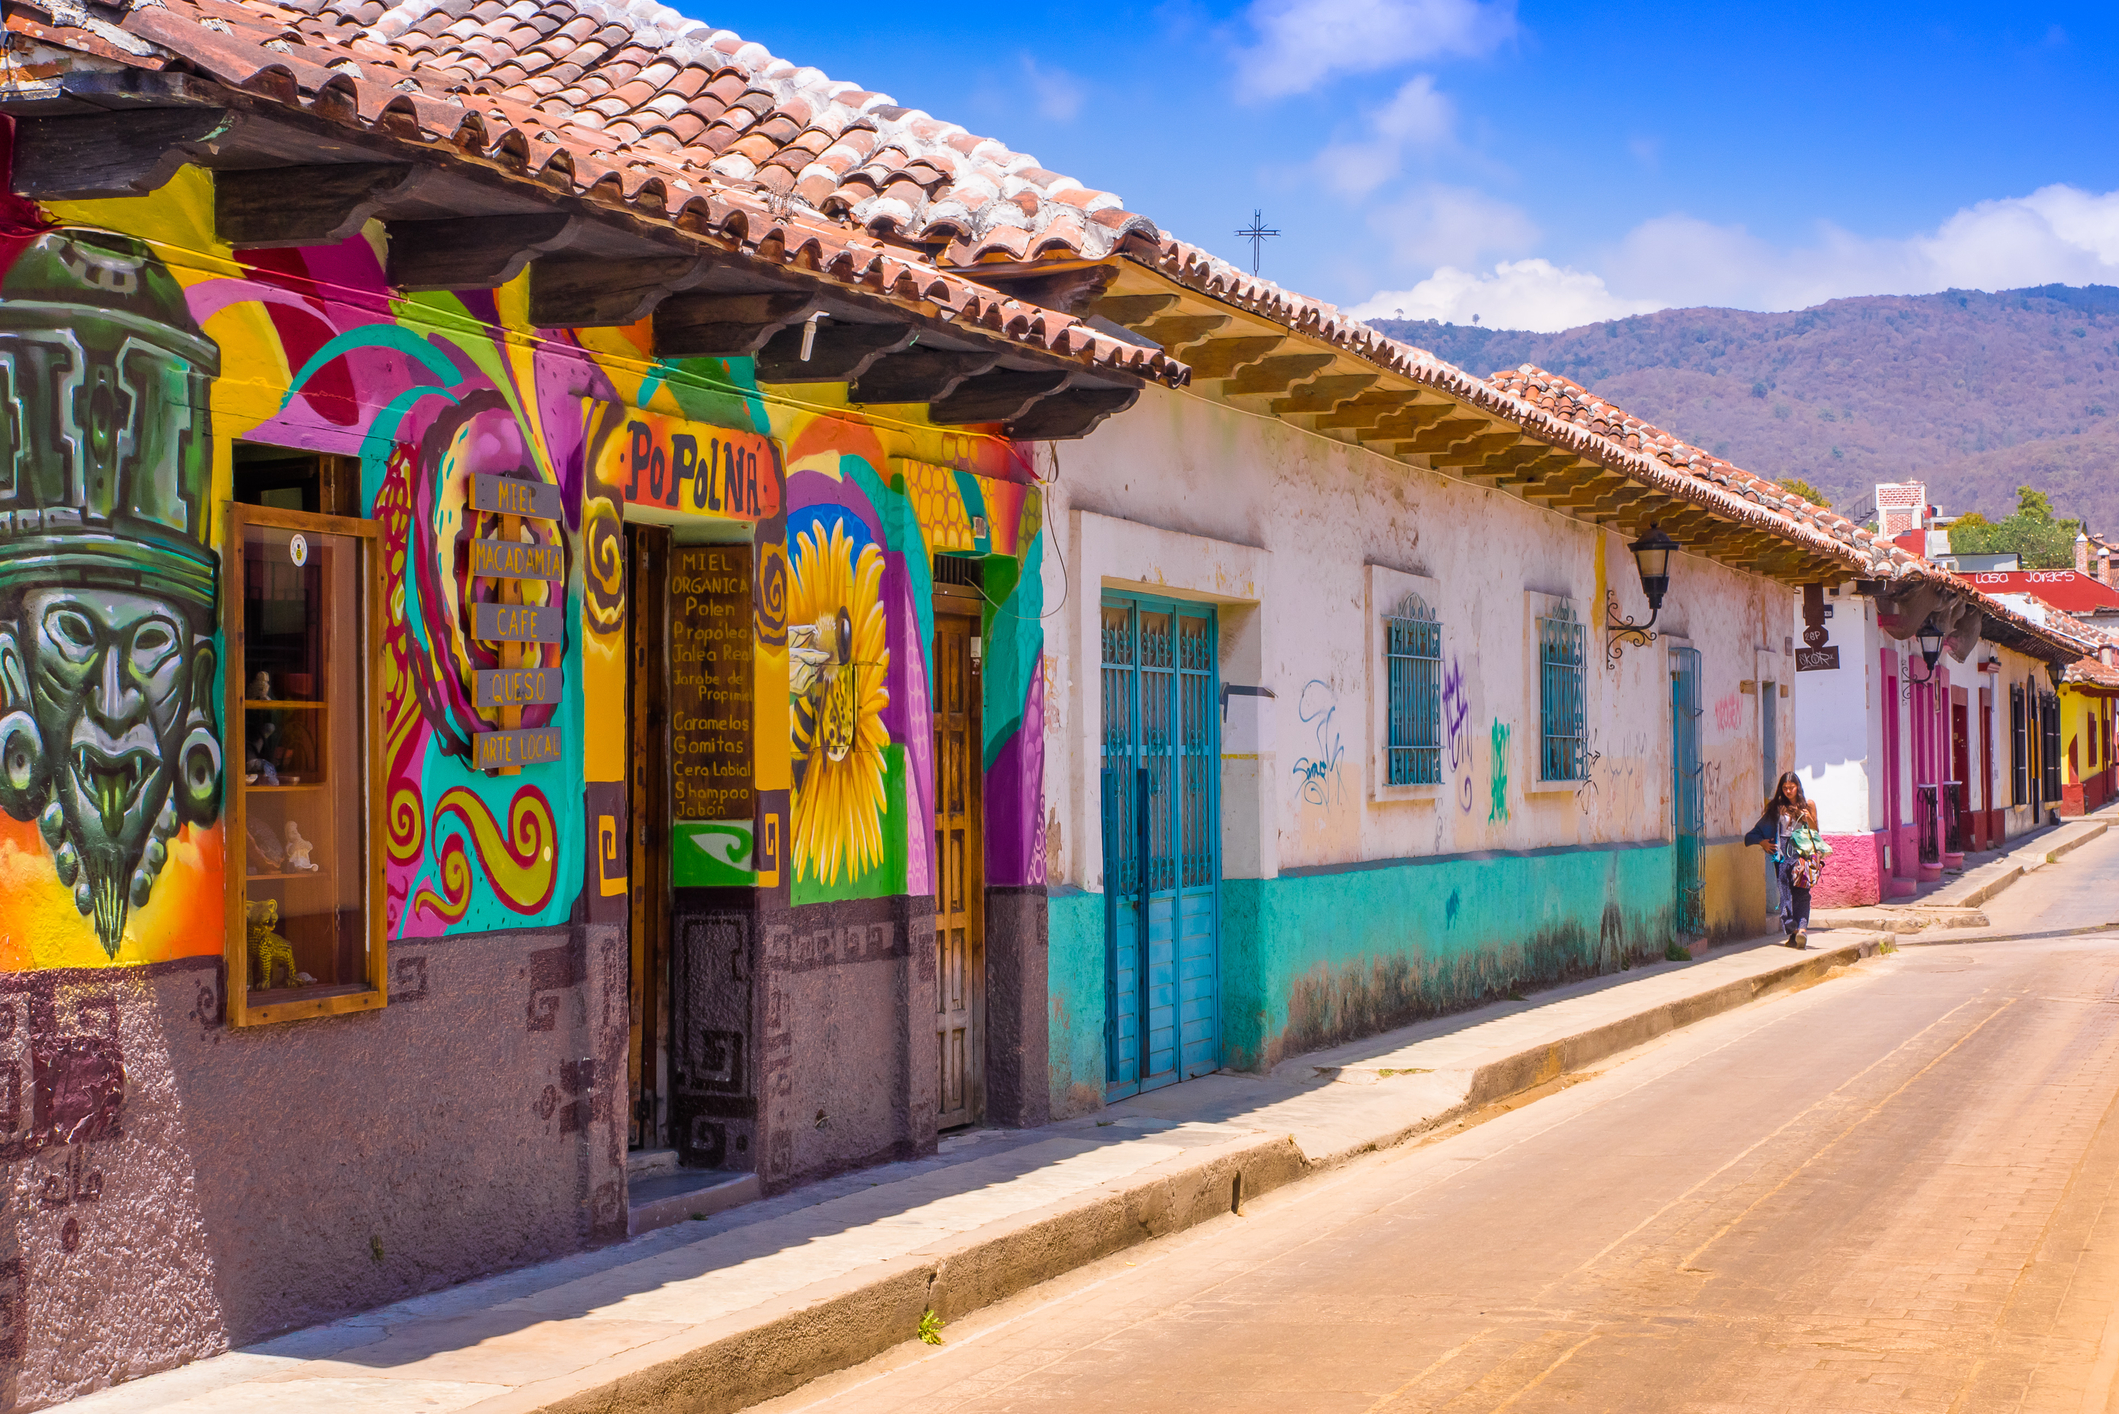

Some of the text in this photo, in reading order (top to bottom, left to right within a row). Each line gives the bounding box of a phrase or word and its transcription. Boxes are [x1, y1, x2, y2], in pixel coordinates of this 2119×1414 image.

[498, 481, 536, 513] MIEL
[476, 543, 561, 576] MACADAMIA
[682, 553, 733, 571] MIEL
[672, 576, 749, 594] ORGANICA
[685, 595, 735, 617] Polen
[497, 608, 538, 638] CAFE
[673, 620, 748, 647] Propóleo
[672, 643, 753, 663] Jalea Real
[492, 672, 545, 703] QUESO
[673, 669, 743, 686] Jarabe de
[673, 711, 749, 732] Caramelos
[482, 734, 560, 765] ARTE LOCAL
[673, 735, 744, 755] Gomitas
[673, 760, 751, 777] Cera Labial
[675, 781, 749, 804] Shampoo
[676, 800, 726, 817] Jabón
